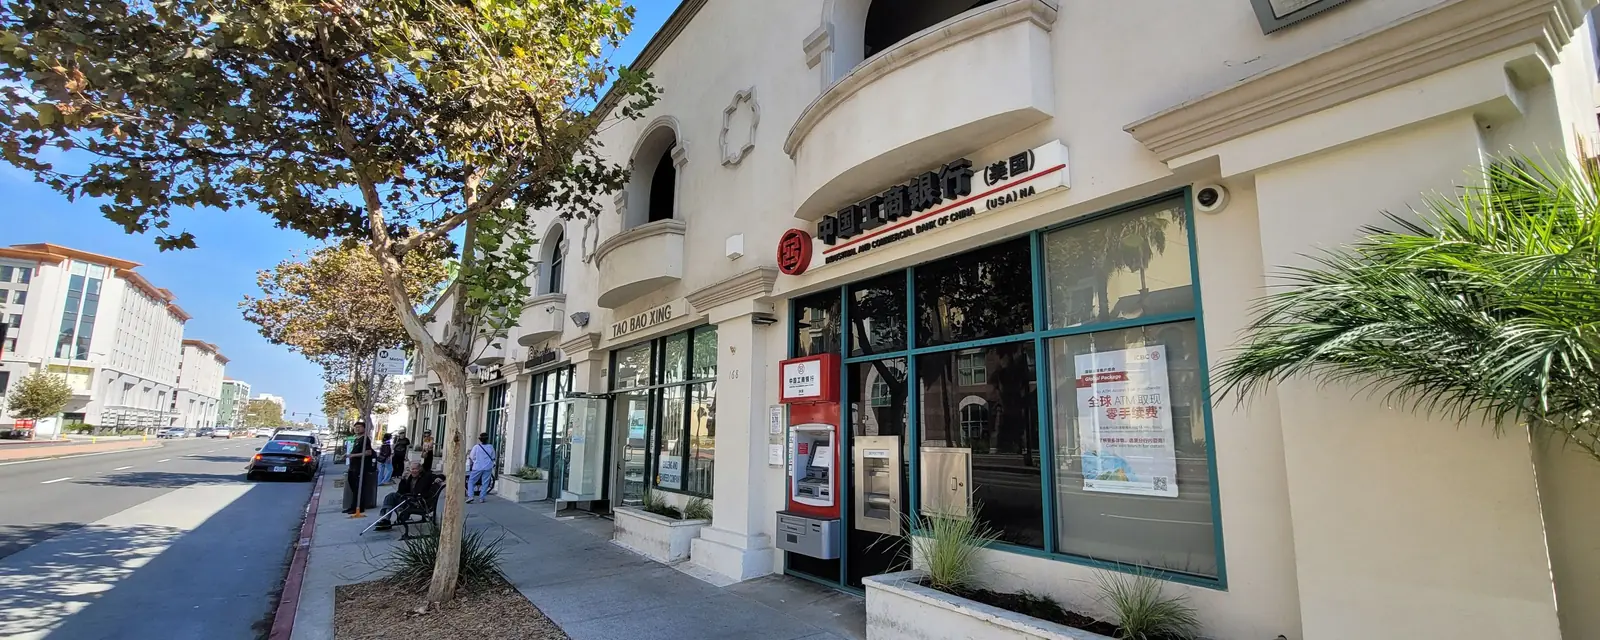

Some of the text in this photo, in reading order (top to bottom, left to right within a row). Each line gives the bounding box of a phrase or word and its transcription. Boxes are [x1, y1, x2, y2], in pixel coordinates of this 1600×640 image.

[818, 149, 1035, 245] 中国工商银行 (美国)
[825, 186, 1036, 264] INDUSTRIAL AND COMMERCIAL BANK OF CHINA (USA) NA
[612, 305, 671, 337] TAO BAO XING
[1133, 353, 1150, 361] ICBC
[729, 369, 739, 380] 168
[788, 375, 815, 384] 中国工商银行
[1088, 393, 1161, 408] 全球 ATM 取现
[1106, 406, 1158, 419] 零手续费
